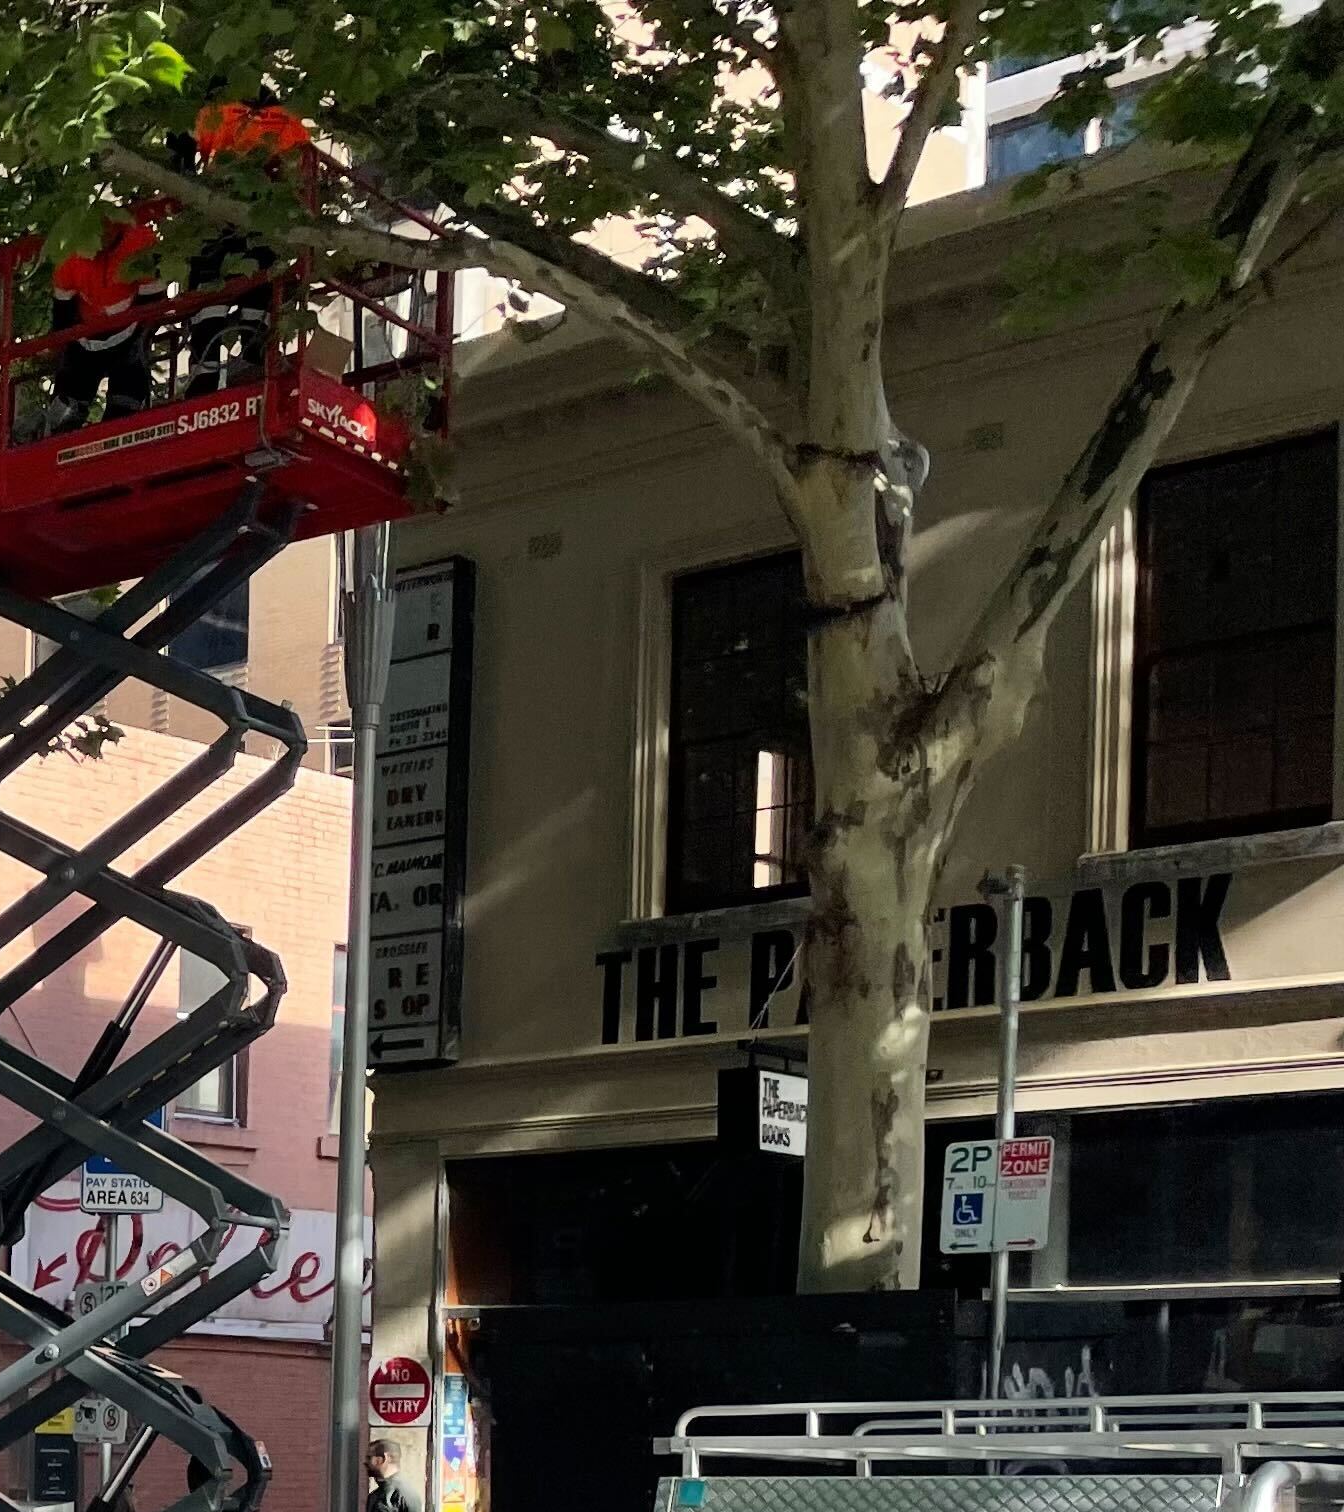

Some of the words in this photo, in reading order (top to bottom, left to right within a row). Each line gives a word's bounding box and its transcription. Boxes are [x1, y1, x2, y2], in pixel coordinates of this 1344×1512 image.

[177, 402, 240, 435] SJ6832
[308, 398, 368, 441] SKYJACK
[595, 938, 719, 1045] THE
[763, 1078, 780, 1099] THE
[1002, 1142, 1050, 1158] PERMIT
[950, 1146, 993, 1173] 2P
[1002, 1159, 1049, 1175] ZONE
[85, 1178, 108, 1188] PAY
[111, 1178, 151, 1188] STATIO
[85, 1190, 127, 1205] AREA
[391, 1369, 410, 1382] NO
[379, 1400, 421, 1413] ENTRY
